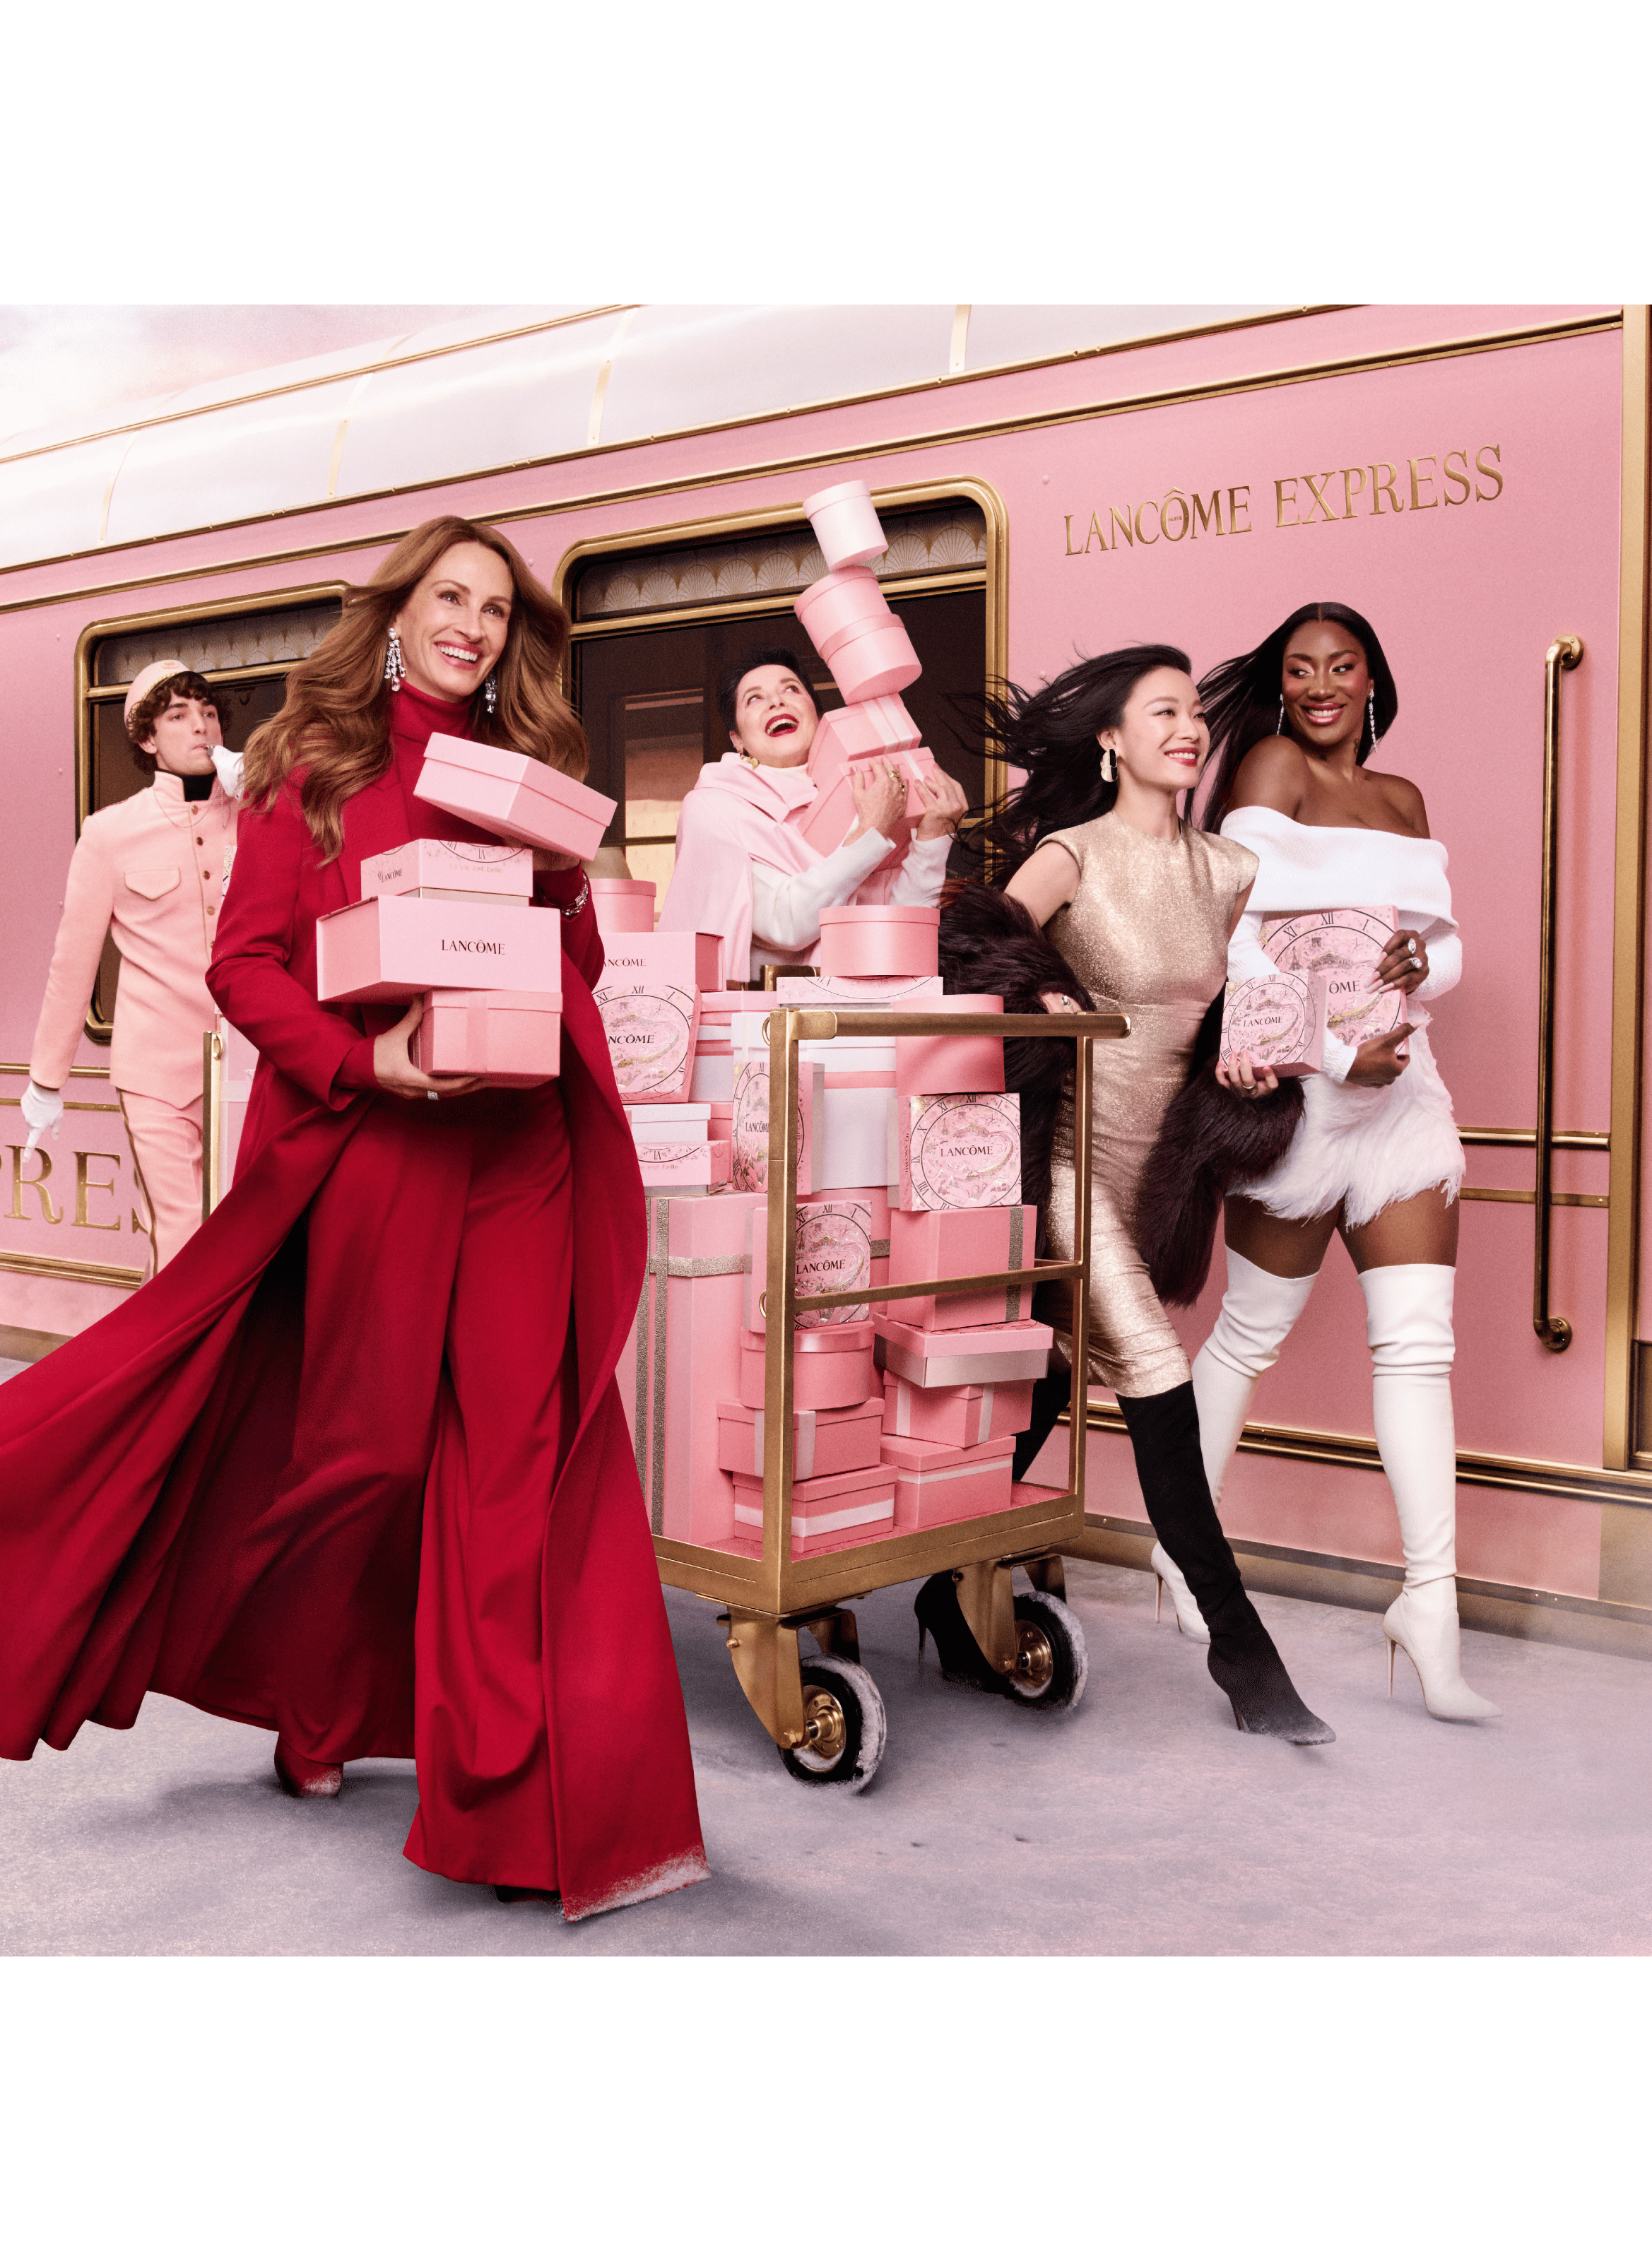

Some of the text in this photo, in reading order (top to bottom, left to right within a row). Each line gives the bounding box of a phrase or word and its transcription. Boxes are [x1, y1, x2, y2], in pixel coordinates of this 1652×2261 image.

[1063, 444, 1504, 556] LANCÔME EXPRESS
[441, 939, 505, 955] LANCÔME
[603, 957, 647, 967] NCÔME
[1329, 980, 1361, 994] ÔME
[1243, 1016, 1284, 1027] LANCÔME
[608, 1034, 655, 1044] NCÔME
[940, 1145, 993, 1157] LANCÔME
[0, 1145, 148, 1234] RE
[796, 1259, 846, 1275] LANCÔME
